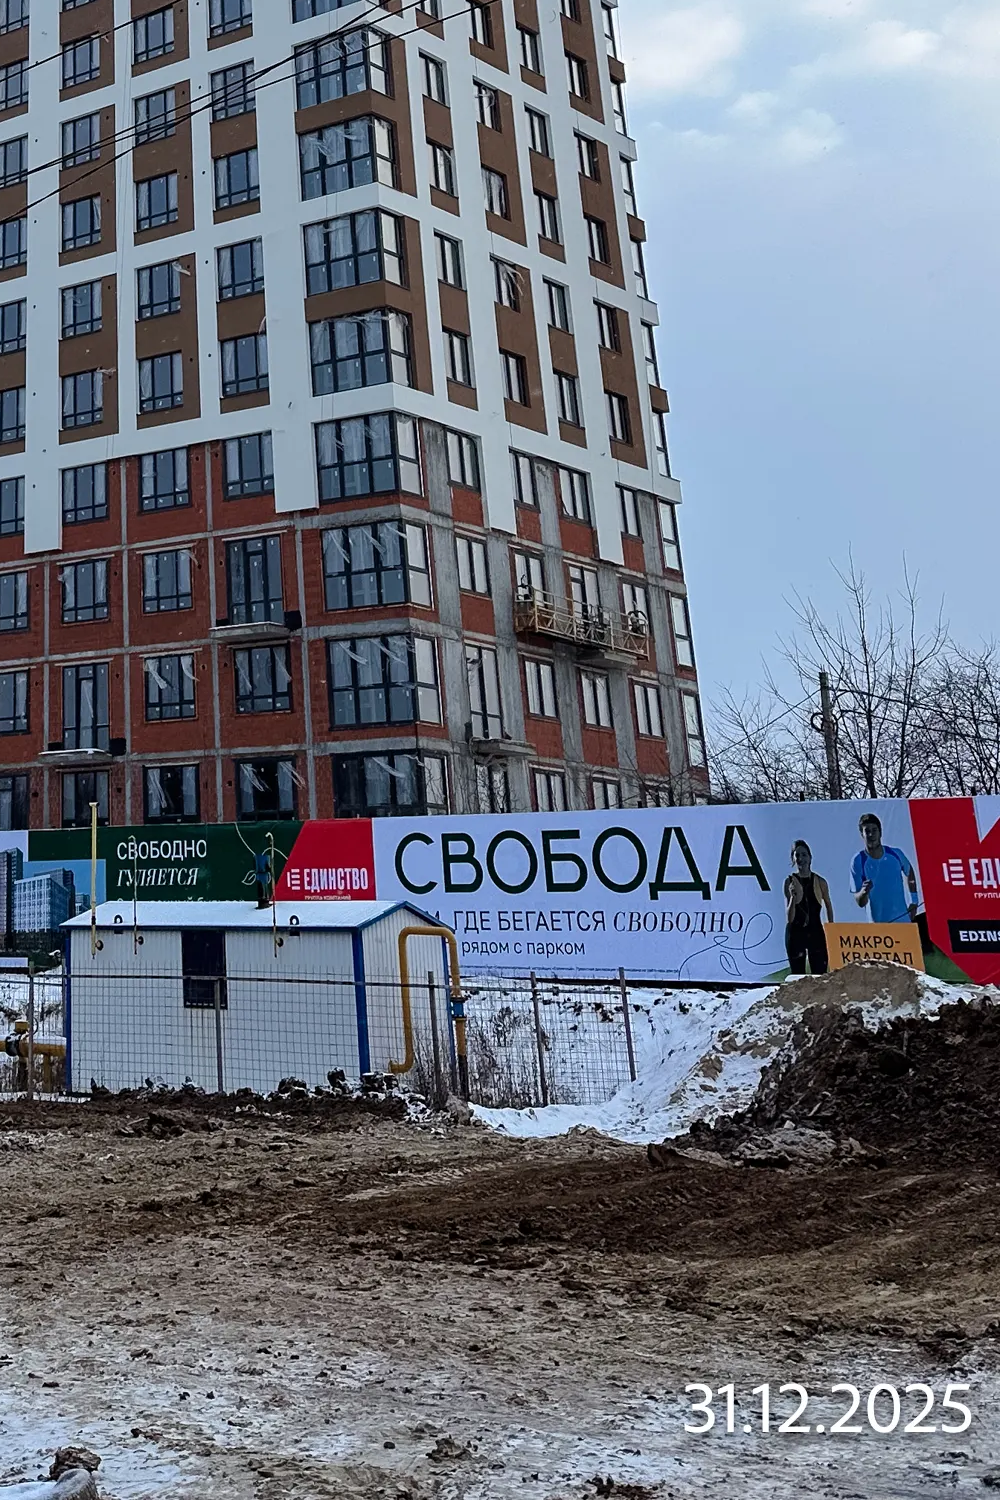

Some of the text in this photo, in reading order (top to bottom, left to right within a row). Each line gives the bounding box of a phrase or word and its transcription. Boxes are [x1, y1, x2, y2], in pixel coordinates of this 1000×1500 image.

[116, 839, 207, 862] СВОБОДНО
[394, 825, 771, 901] СВОБОДА
[116, 867, 199, 887] ГУЛЯЕТСЯ
[303, 867, 369, 893] ЕДИНСТВО
[453, 910, 492, 935] ГДЕ
[497, 910, 606, 932] БЕГАЕТСЯ
[613, 911, 744, 938] СВОБОДНО
[461, 941, 586, 958] рядом с парком
[839, 935, 901, 949] МАКРО-
